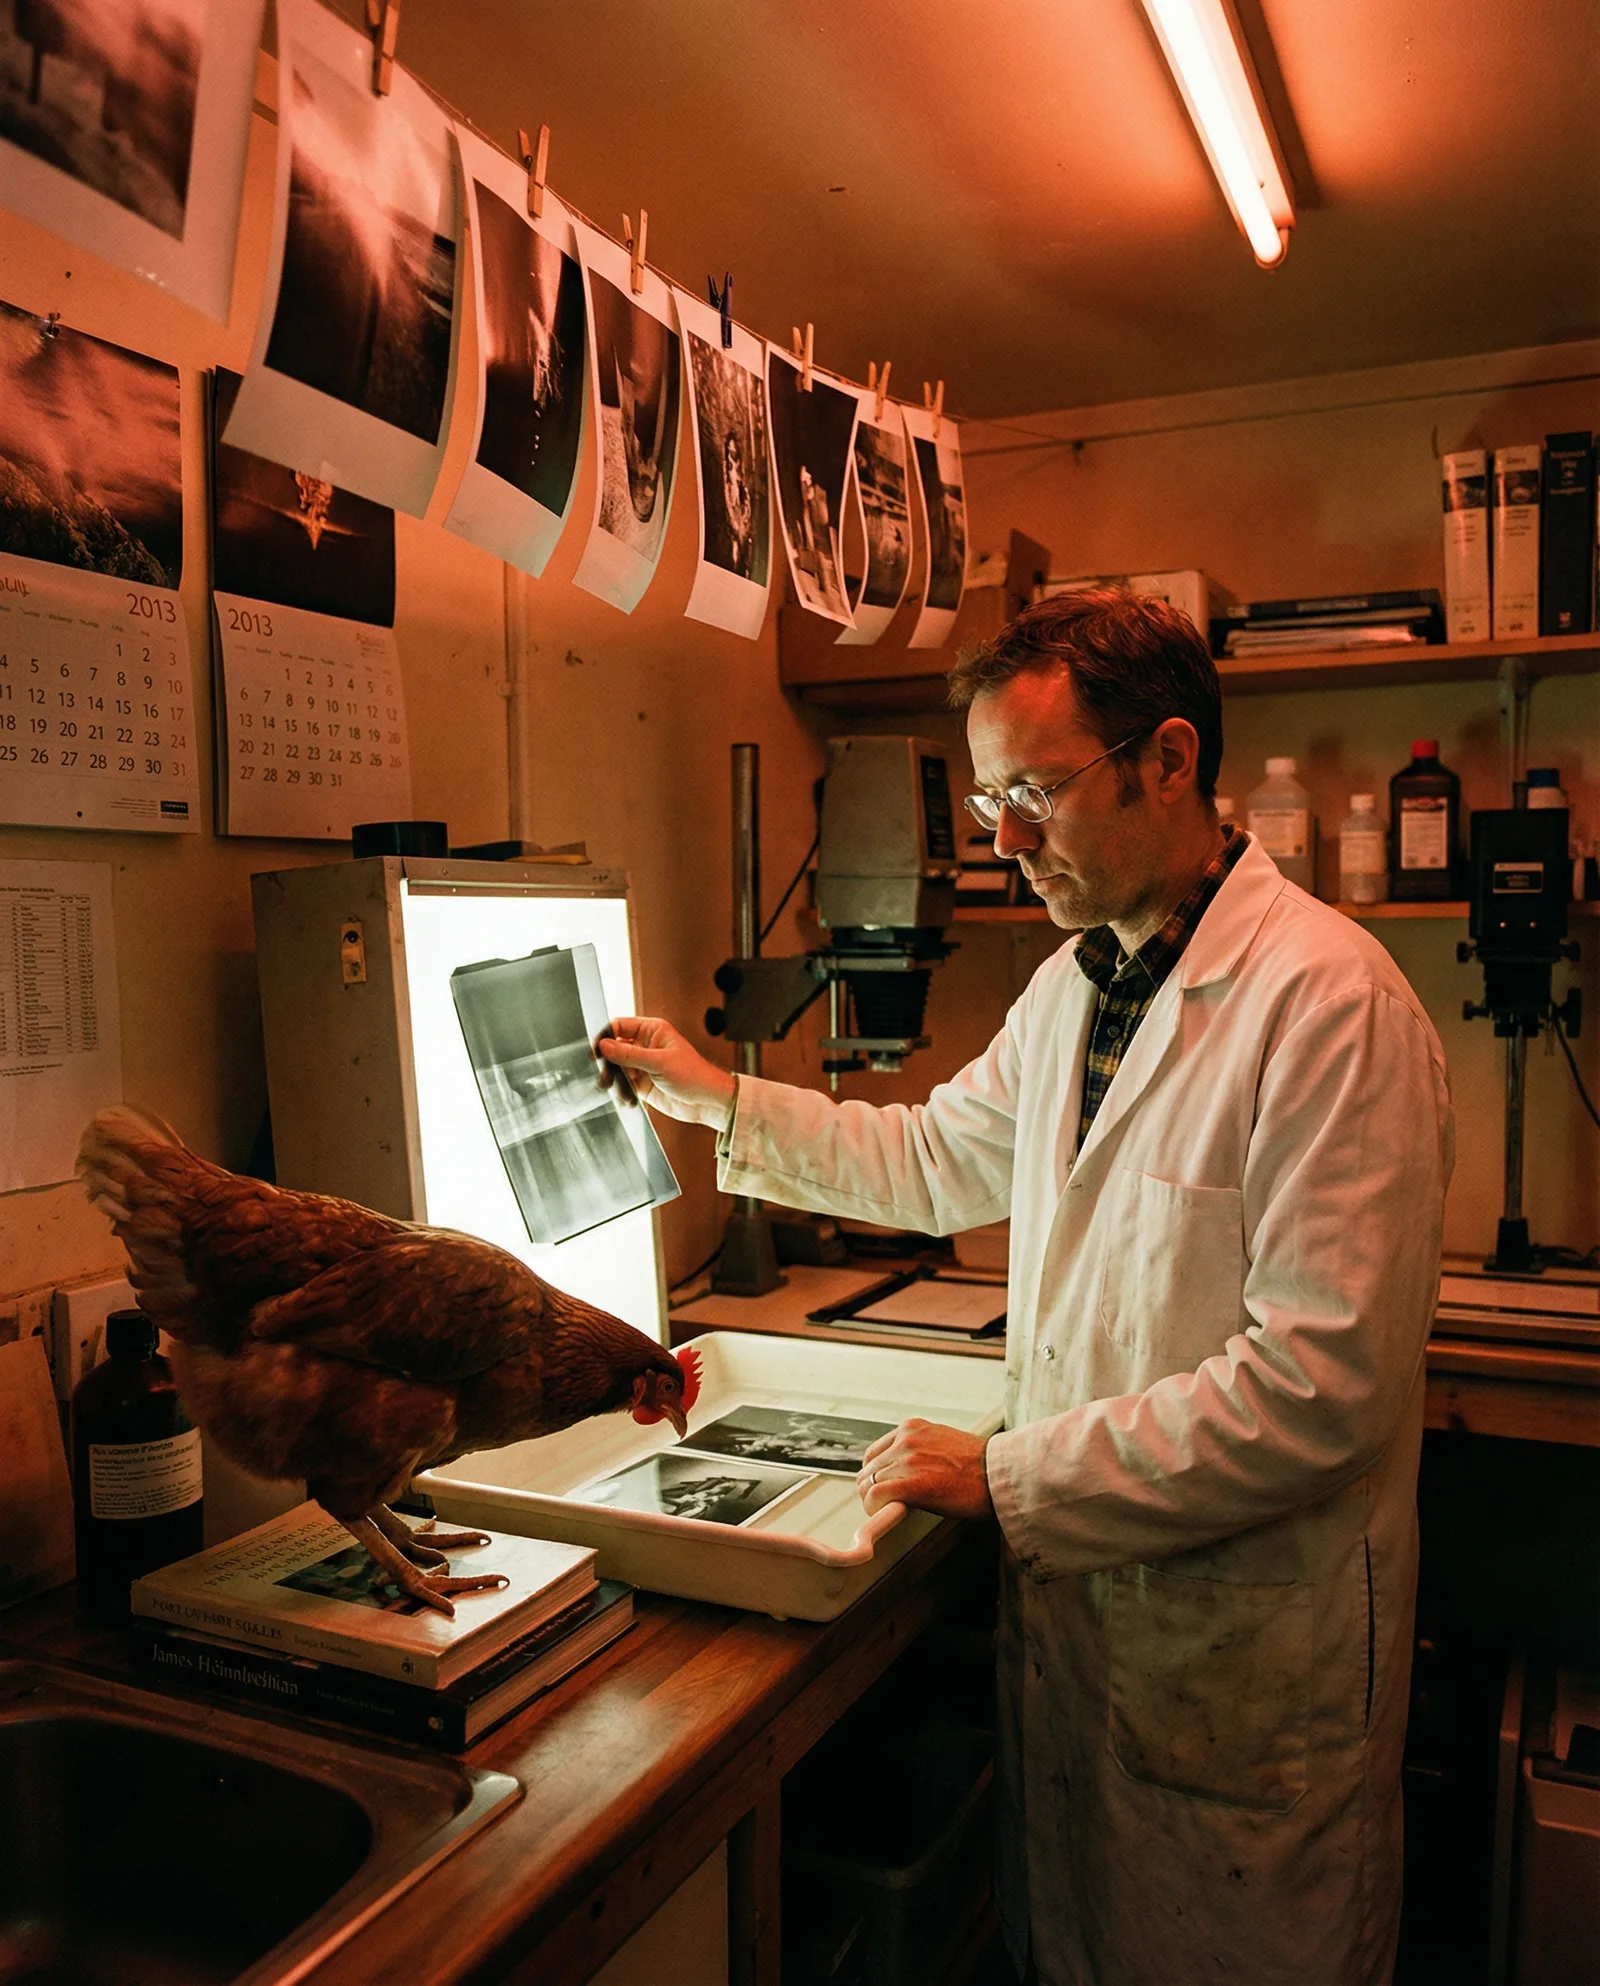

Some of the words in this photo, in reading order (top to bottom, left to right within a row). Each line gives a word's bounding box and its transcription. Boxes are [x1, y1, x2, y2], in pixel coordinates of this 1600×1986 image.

[127, 593, 177, 623] 2013
[228, 609, 273, 637] 2013
[116, 644, 122, 658] 1
[143, 648, 150, 663] 2
[169, 652, 177, 667] 3
[0, 654, 9, 670] 4
[30, 659, 40, 674] 5
[60, 664, 70, 678] 6
[90, 667, 98, 681] 7
[117, 672, 126, 686] 8
[144, 676, 153, 690] 9
[168, 680, 183, 695] 10
[286, 668, 290, 681] 1
[306, 672, 313, 685] 2
[327, 675, 334, 688] 3
[348, 679, 355, 692] 4
[368, 681, 374, 695] 5
[28, 688, 46, 705] 12
[59, 693, 75, 708] 13
[88, 696, 104, 712] 14
[116, 700, 132, 715] 15
[143, 704, 159, 719] 16
[170, 707, 184, 722] 17
[241, 687, 249, 701] 6
[264, 690, 271, 704] 7
[286, 693, 294, 708] 8
[308, 697, 315, 710] 9
[327, 700, 340, 714] 10
[347, 703, 358, 715] 11
[367, 705, 379, 719] 12
[0, 715, 17, 731] 18
[30, 719, 47, 734] 19
[60, 722, 78, 738] 20
[89, 725, 104, 741] 21
[117, 728, 134, 744] 22
[144, 732, 160, 747] 23
[171, 735, 186, 749] 24
[240, 713, 253, 728] 13
[263, 716, 276, 729] 14
[285, 719, 298, 733] 15
[307, 721, 320, 736] 16
[328, 724, 340, 738] 17
[348, 727, 361, 741] 18
[369, 729, 381, 743] 19
[0, 746, 18, 762] 25
[31, 748, 49, 765] 26
[61, 751, 79, 767] 27
[90, 754, 108, 770] 28
[118, 757, 135, 772] 29
[145, 760, 162, 775] 30
[172, 762, 187, 777] 31
[240, 740, 254, 754] 20
[262, 742, 275, 756] 21
[286, 745, 300, 760] 22
[307, 747, 321, 761] 23
[329, 749, 343, 763] 24
[350, 751, 363, 765] 25
[241, 766, 256, 780] 27
[263, 768, 278, 782] 28
[287, 770, 301, 785] 29
[308, 772, 323, 786] 30
[330, 774, 343, 787] 31
[152, 1643, 193, 1668] James
